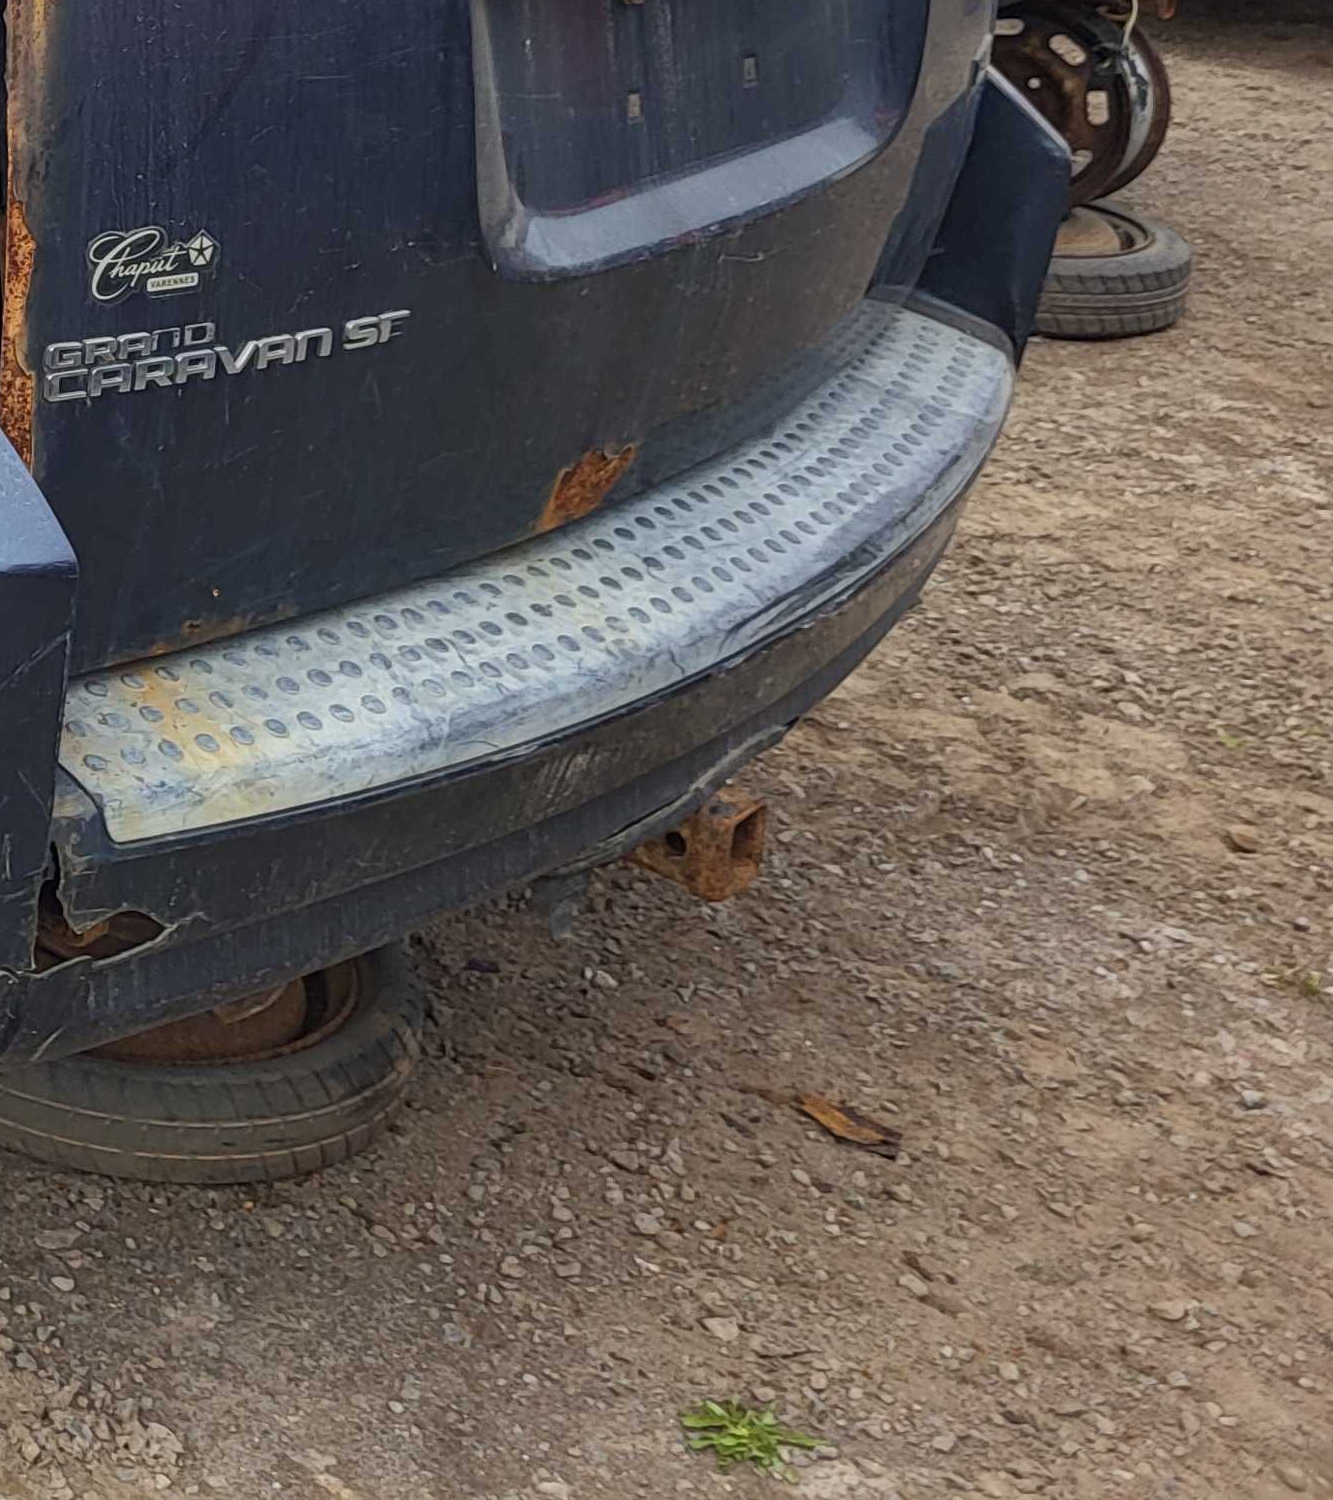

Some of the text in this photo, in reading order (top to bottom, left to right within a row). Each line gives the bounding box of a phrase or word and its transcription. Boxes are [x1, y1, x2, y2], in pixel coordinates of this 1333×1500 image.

[89, 226, 187, 300] Chaput
[44, 322, 216, 370] GRAND
[44, 328, 332, 402] CARAVAN
